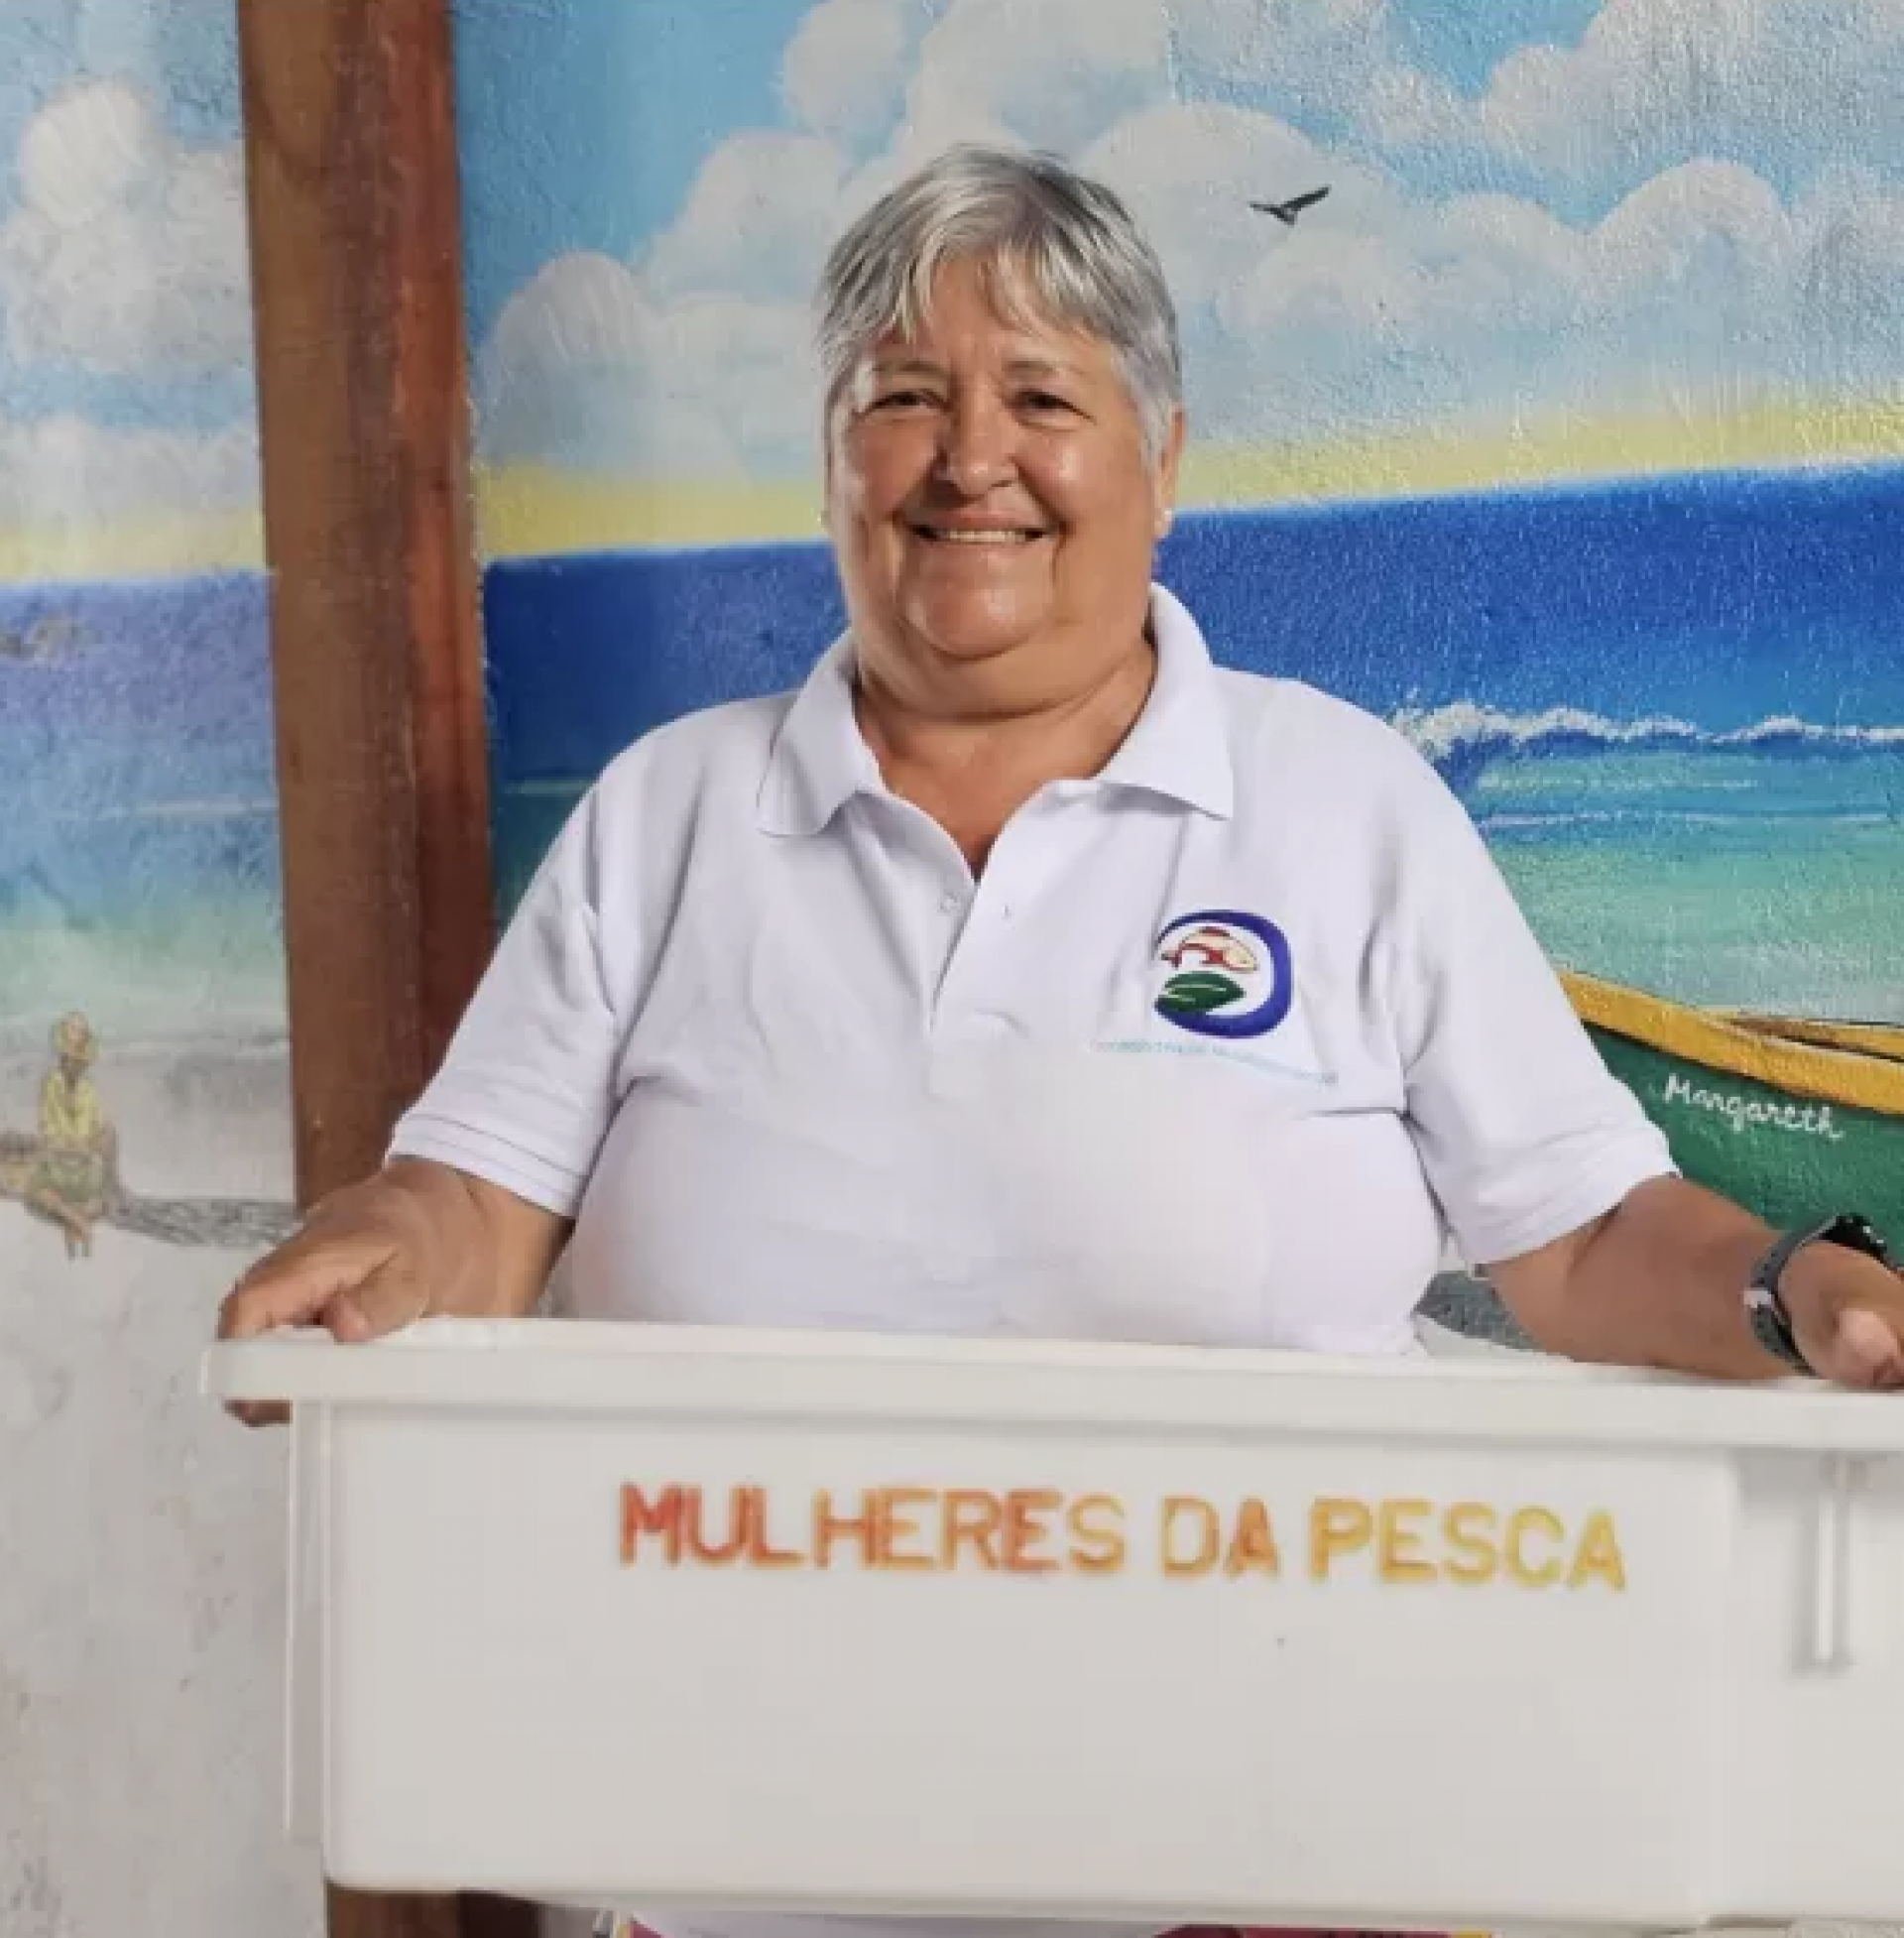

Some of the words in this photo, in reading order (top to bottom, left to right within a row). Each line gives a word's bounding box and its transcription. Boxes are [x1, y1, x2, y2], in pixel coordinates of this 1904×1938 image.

[1663, 1073, 1845, 1140] Margareth
[619, 1482, 1126, 1574] MULHERES
[1161, 1496, 1280, 1581] DA
[1310, 1496, 1626, 1592] PESCA
